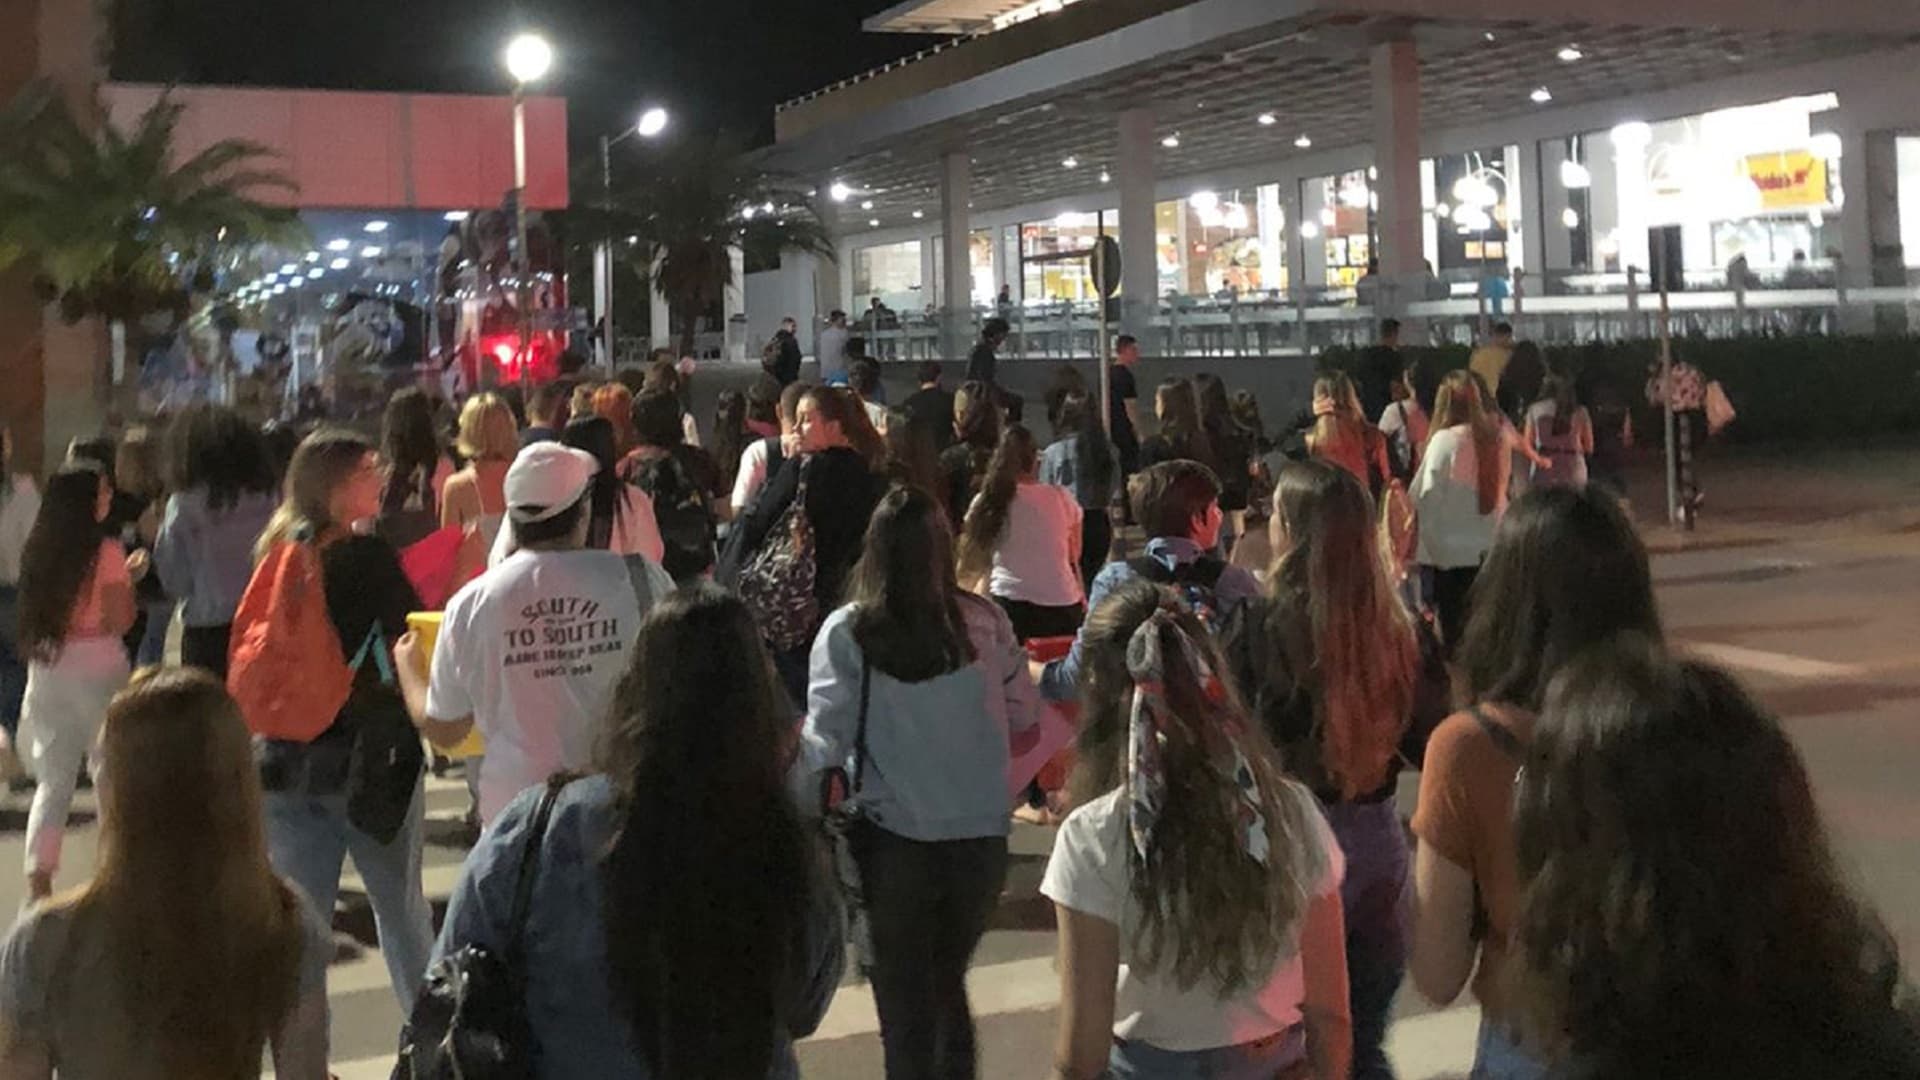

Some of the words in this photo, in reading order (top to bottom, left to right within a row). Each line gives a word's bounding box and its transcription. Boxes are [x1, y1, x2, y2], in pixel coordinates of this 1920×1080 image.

[521, 596, 599, 624] SOUTH
[504, 628, 535, 648] TO
[543, 618, 617, 646] SOUTH
